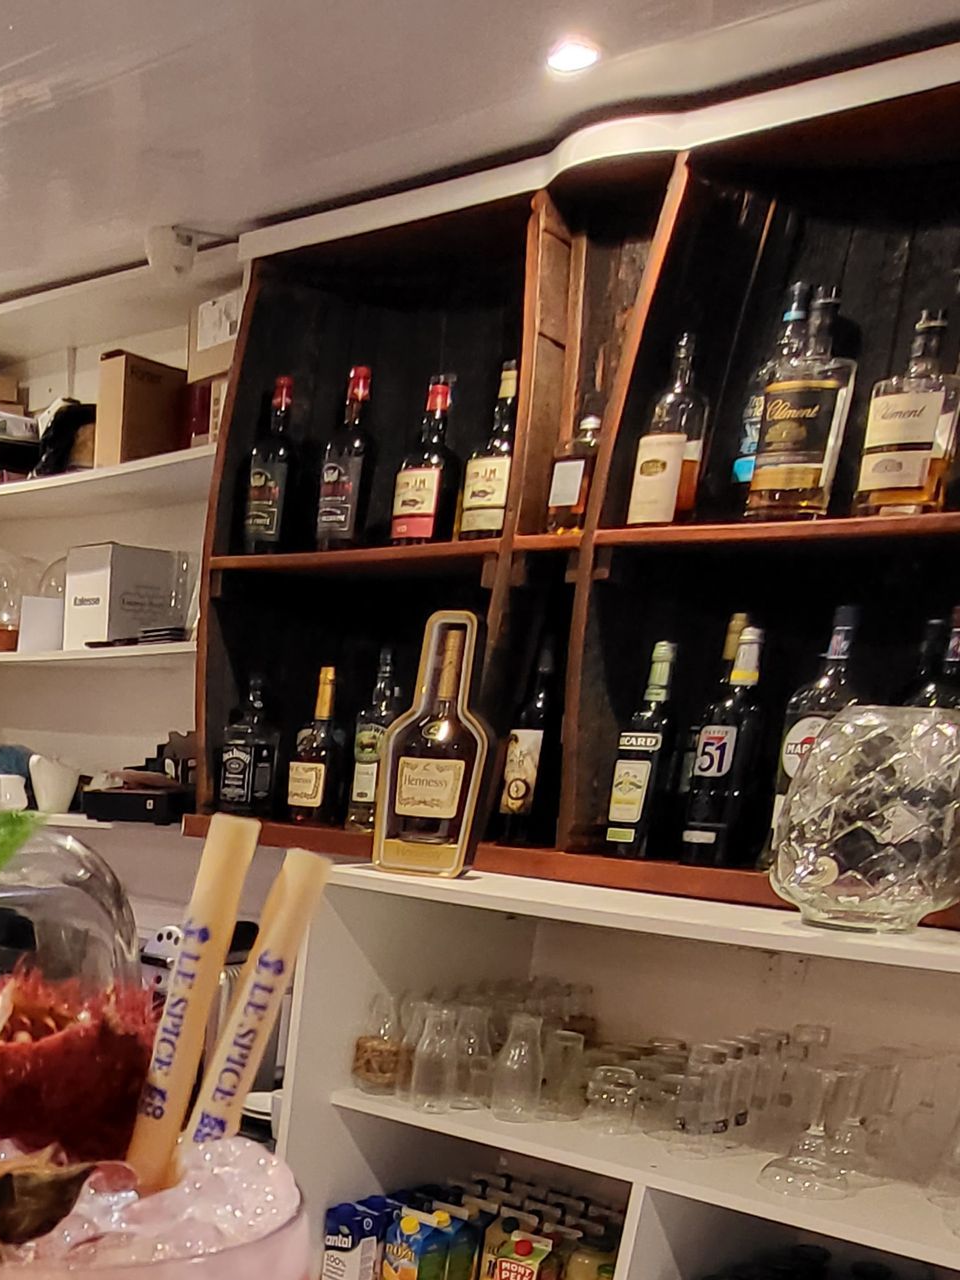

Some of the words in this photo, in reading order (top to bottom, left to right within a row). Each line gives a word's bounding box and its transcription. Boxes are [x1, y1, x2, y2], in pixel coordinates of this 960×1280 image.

[620, 736, 657, 747] CARD
[698, 741, 727, 773] 51
[177, 949, 201, 990] LE
[243, 980, 275, 1020] LE
[324, 1234, 353, 1248] antal
[501, 1261, 532, 1277] MONT
